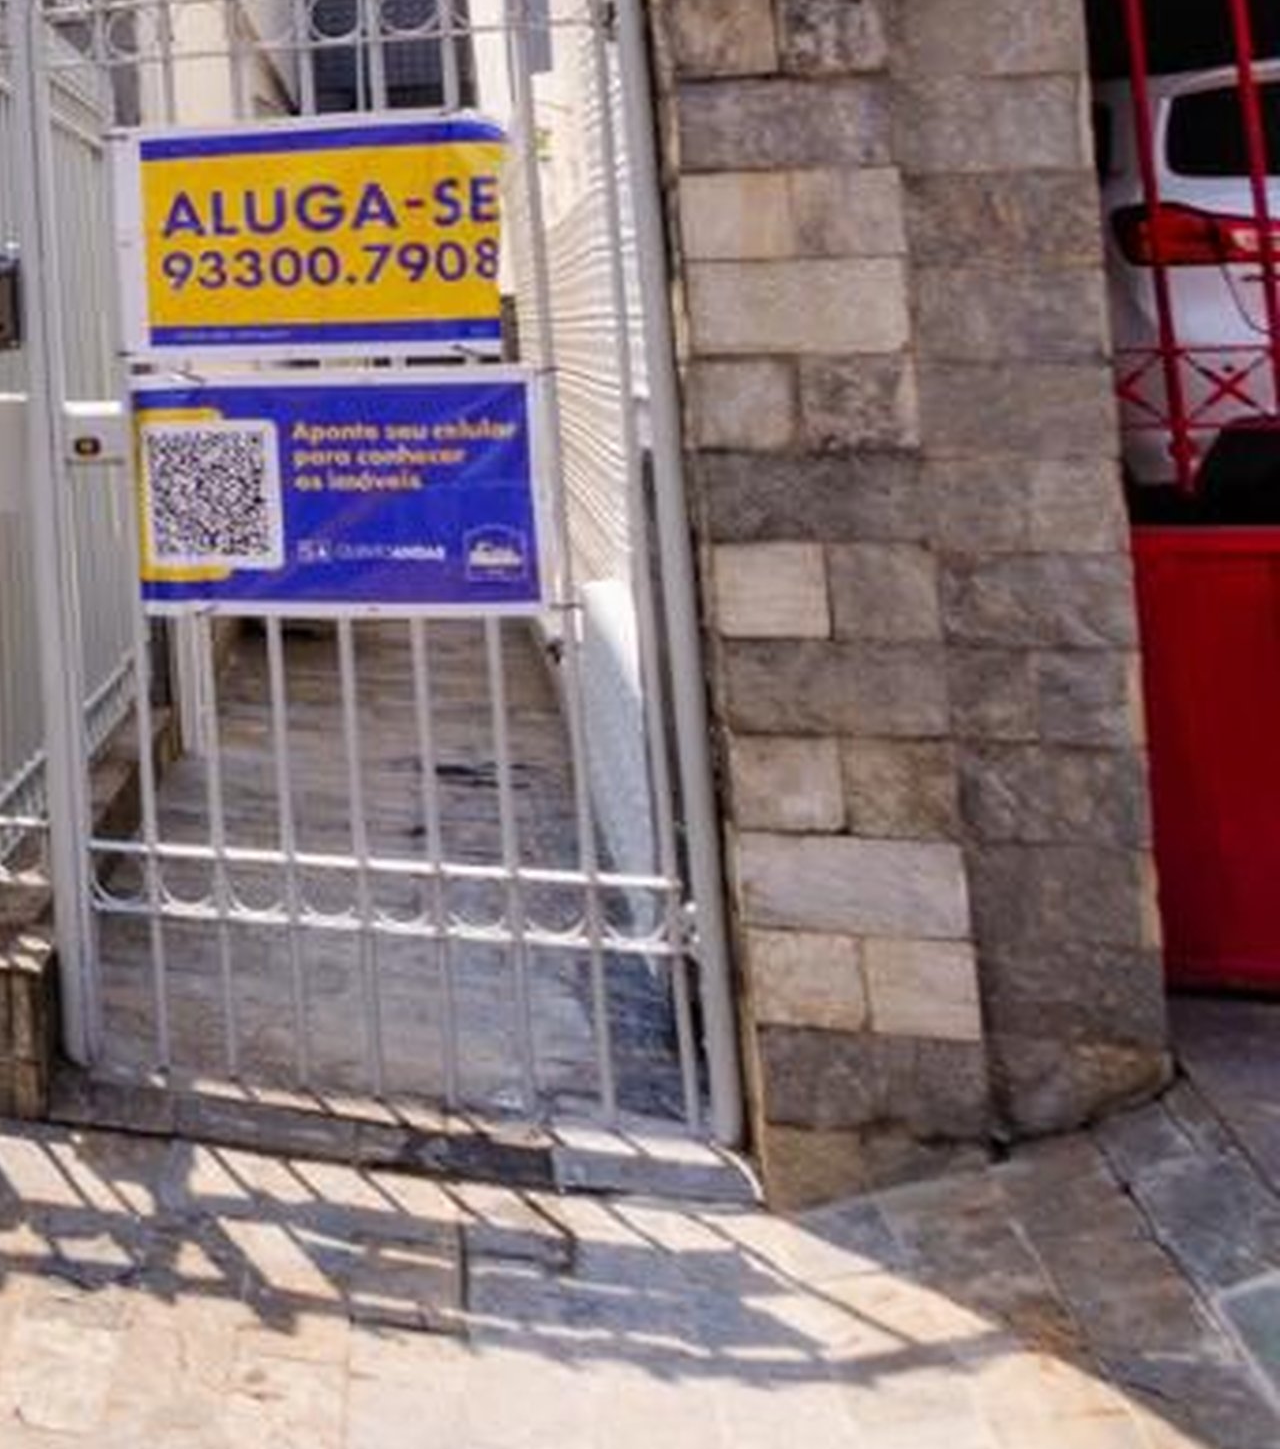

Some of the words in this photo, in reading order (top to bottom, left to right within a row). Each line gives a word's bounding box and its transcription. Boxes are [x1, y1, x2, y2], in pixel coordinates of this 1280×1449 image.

[163, 176, 498, 238] ALUGA-SE
[162, 238, 498, 290] 93300.7908
[292, 422, 380, 446] Aponte
[385, 424, 428, 441] seu
[292, 450, 352, 470] para
